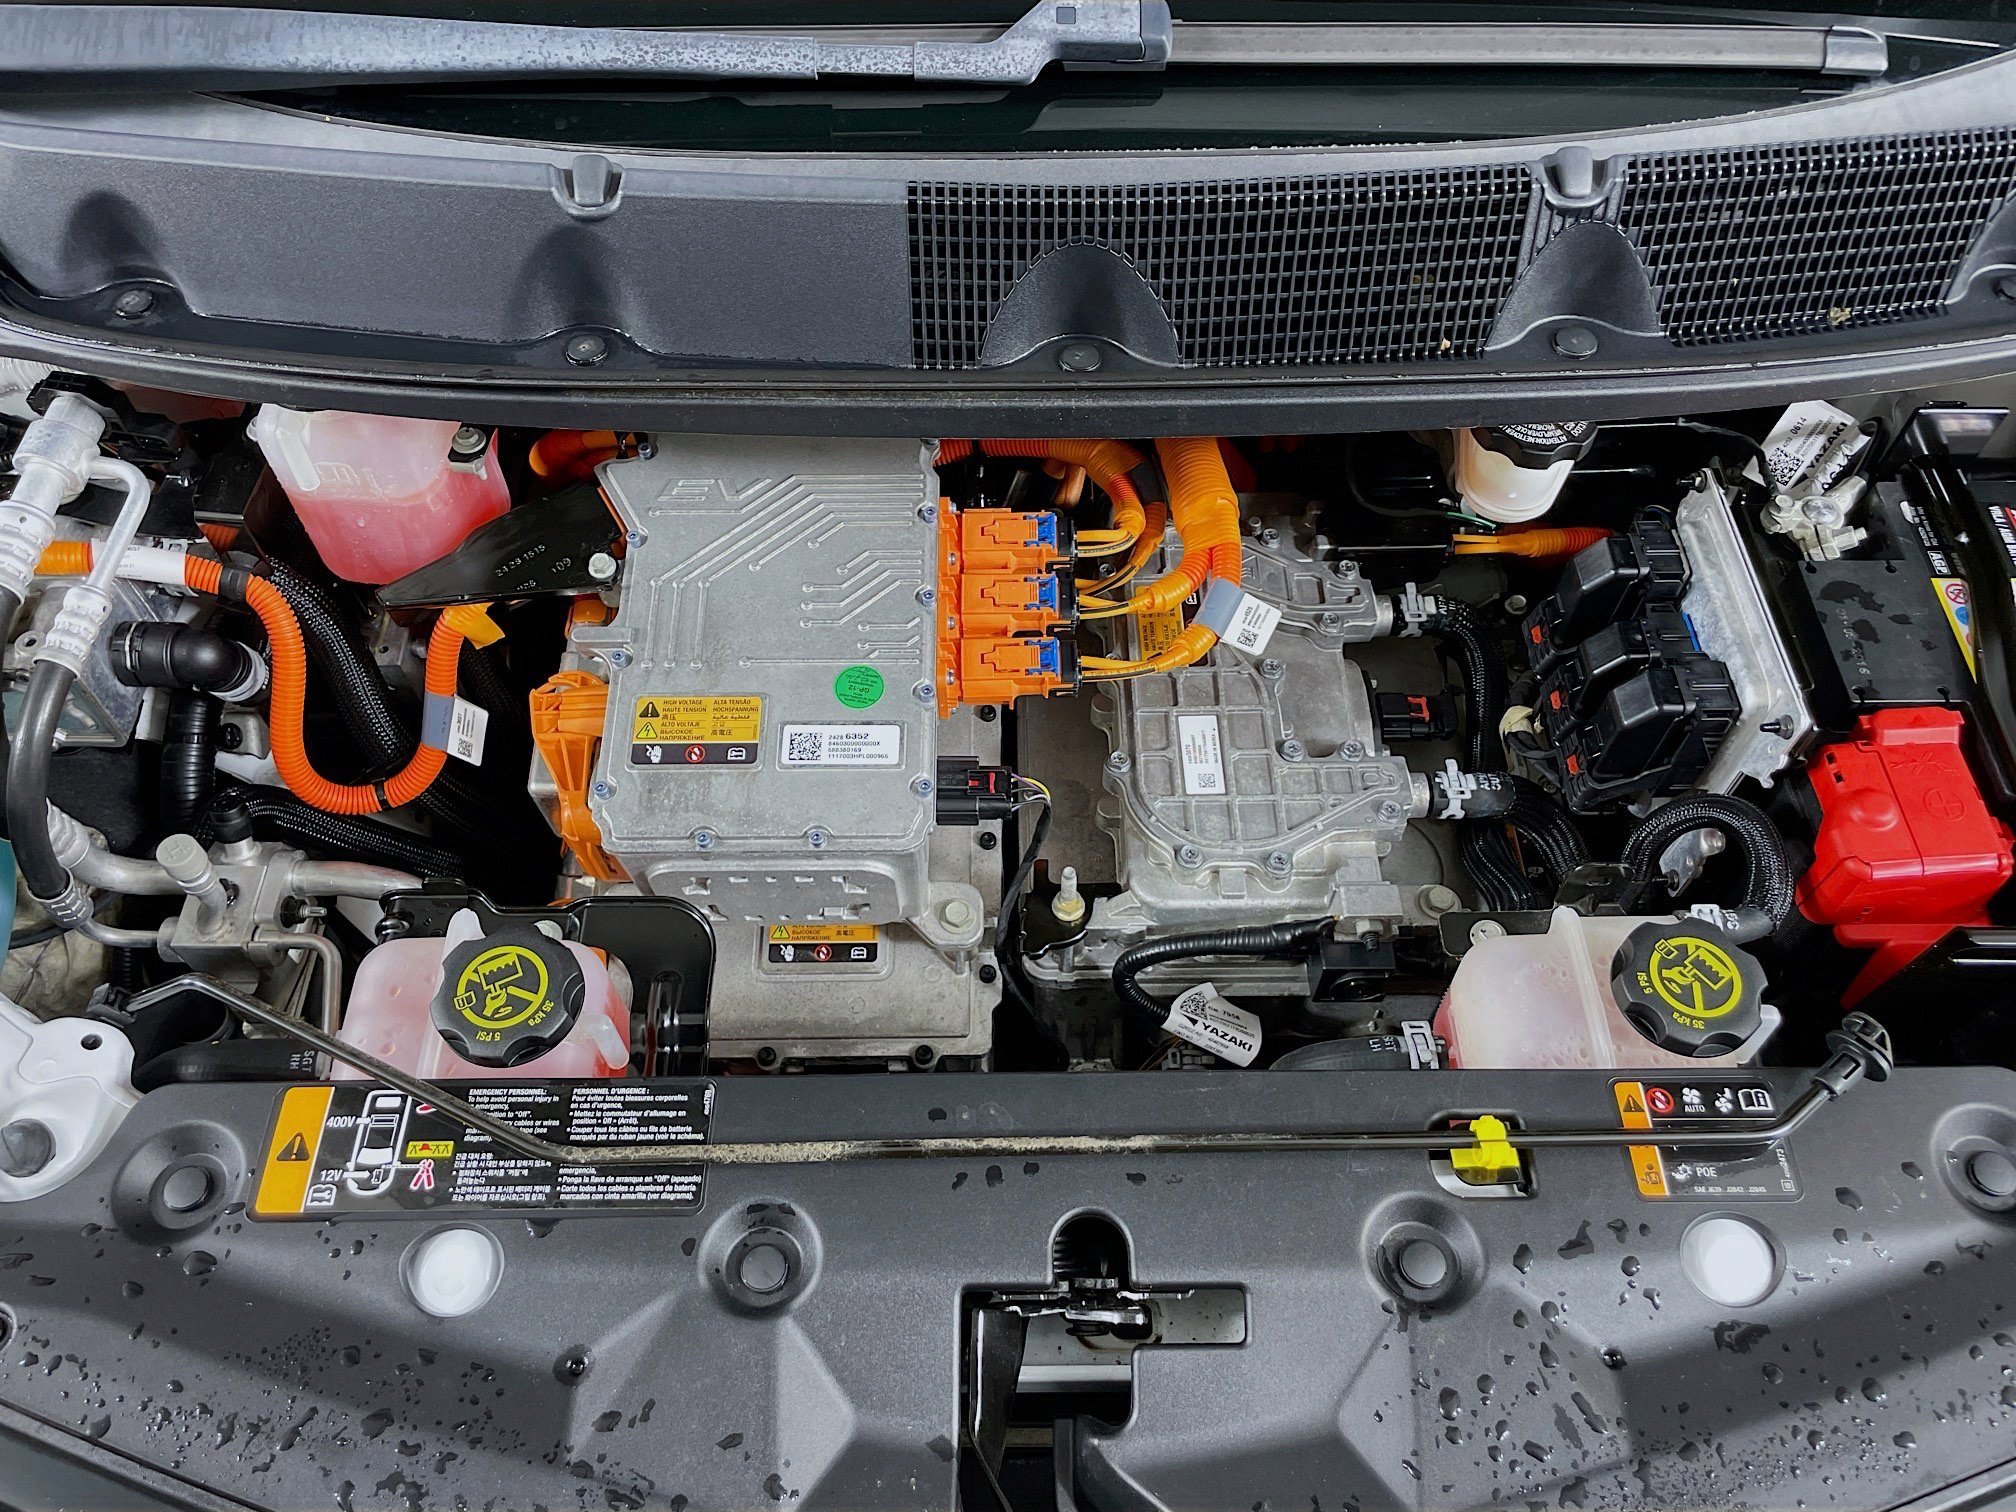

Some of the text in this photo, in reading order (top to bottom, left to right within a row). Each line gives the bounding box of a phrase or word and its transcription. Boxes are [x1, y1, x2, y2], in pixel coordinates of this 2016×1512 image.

[1790, 416, 1808, 435] 0614
[1806, 422, 1848, 469] YAZAKI
[1930, 552, 1950, 574] AGP
[848, 685, 870, 693] GP-12
[1637, 972, 1654, 995] 5 PSI
[542, 1000, 555, 1013] 35
[1672, 1011, 1705, 1030] 35 kPa
[476, 1030, 501, 1041] 5 PSI
[1202, 1021, 1253, 1052] YAZAKI
[290, 1054, 301, 1070] RH
[302, 1050, 315, 1072] SGT
[1684, 1104, 1706, 1113] AUTO
[326, 1116, 356, 1127] 400V
[570, 1133, 596, 1141] marqués
[637, 1133, 654, 1141] jaune
[656, 1133, 669, 1141] (voir
[320, 1169, 344, 1181] 12V
[559, 1167, 597, 1175] emergencia,
[1696, 1166, 1718, 1177] POE
[671, 1175, 702, 1183] (apagado)
[648, 1192, 660, 1200] (ver
[661, 1192, 693, 1200] diagrama).
